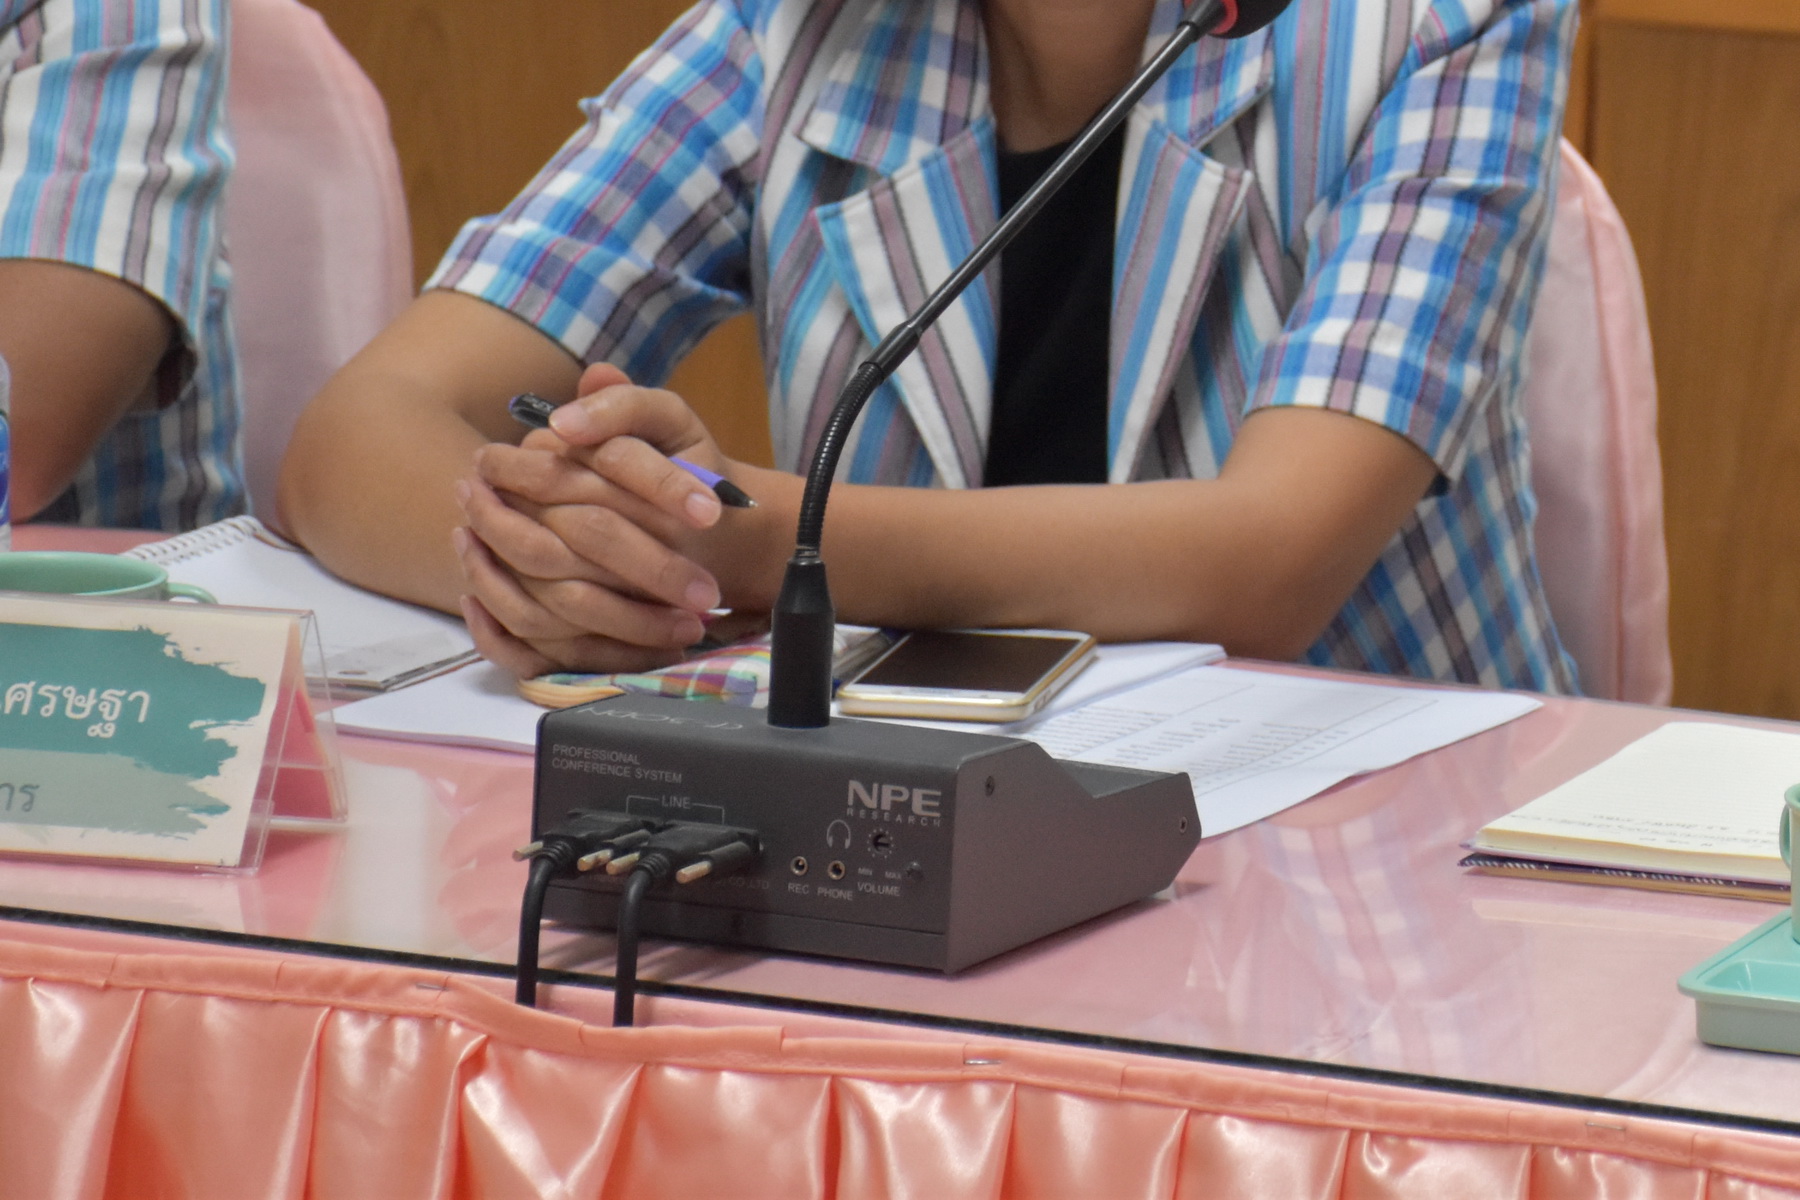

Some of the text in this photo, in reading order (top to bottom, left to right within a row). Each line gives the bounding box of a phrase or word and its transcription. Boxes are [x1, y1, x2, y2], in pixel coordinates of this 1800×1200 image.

[0, 681, 150, 738] ศรษฐา
[552, 743, 641, 765] PROFESSIONAL
[552, 757, 683, 784] CONFERENCE SYSTEM
[661, 795, 692, 809] LINE
[848, 779, 942, 817] NPE
[846, 808, 941, 828] RESEARCH
[858, 867, 873, 877] MIN
[787, 882, 810, 895] REC
[817, 887, 853, 901] PHONE
[857, 881, 901, 897] VOLUME
